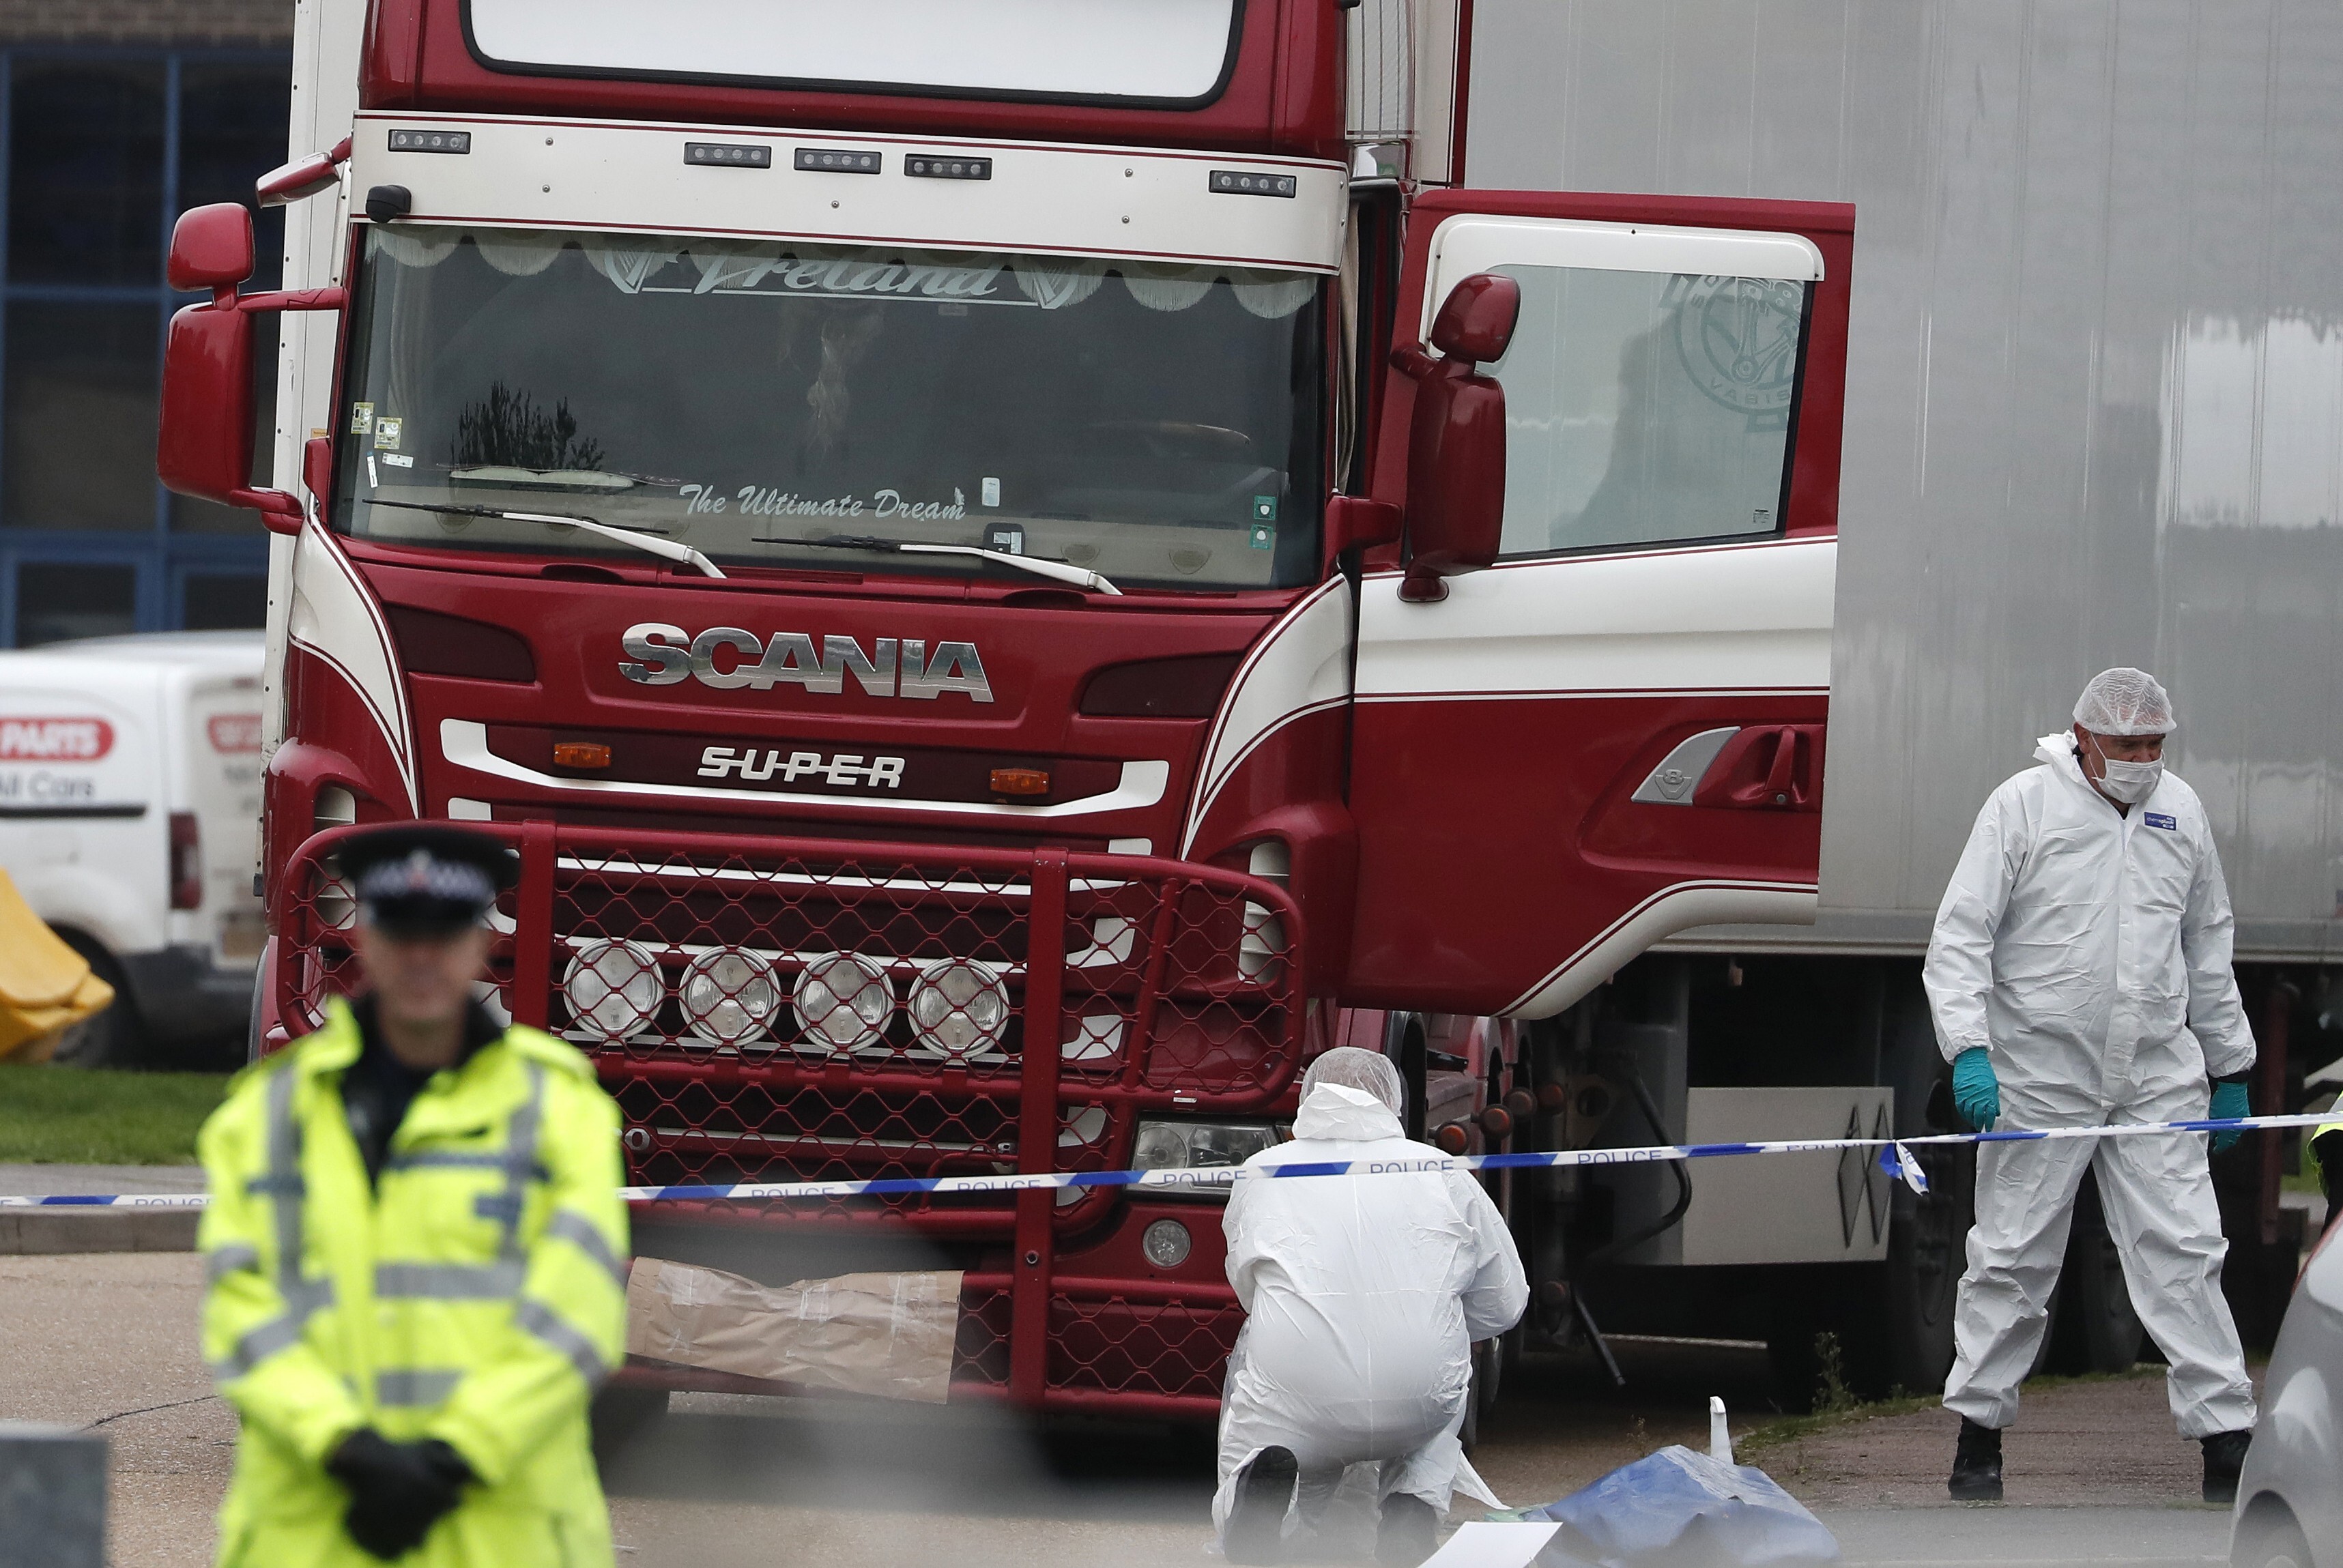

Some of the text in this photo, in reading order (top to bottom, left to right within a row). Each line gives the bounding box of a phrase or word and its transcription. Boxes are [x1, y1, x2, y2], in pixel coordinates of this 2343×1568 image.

[680, 484, 966, 521] The Ultimate Dream
[618, 623, 994, 702] SCANIA
[697, 746, 905, 788] SUPER
